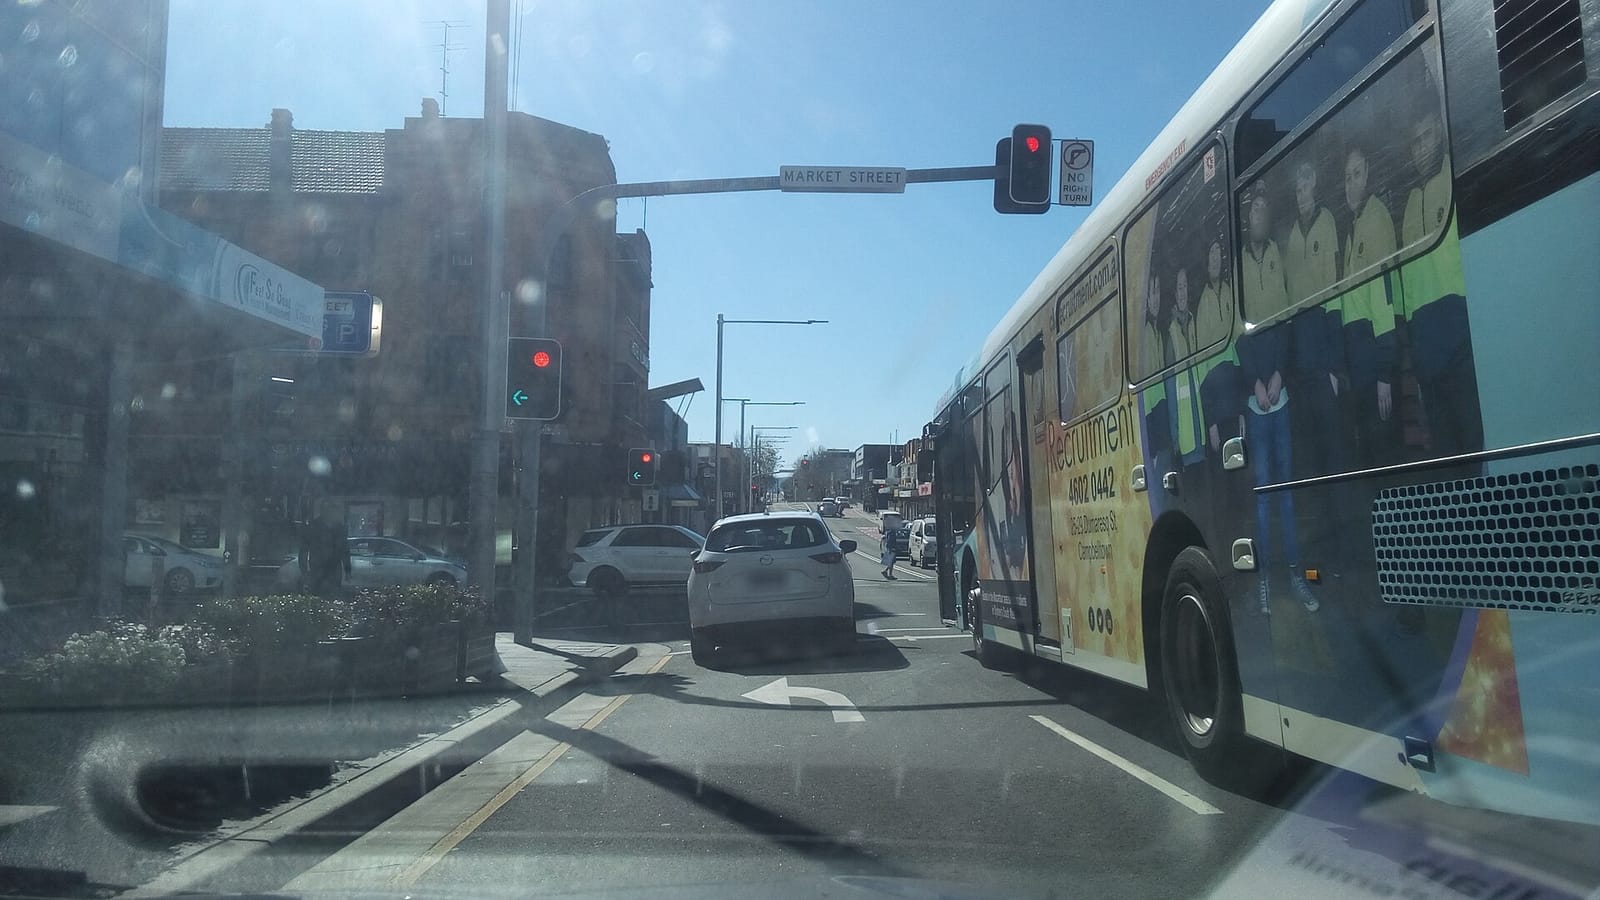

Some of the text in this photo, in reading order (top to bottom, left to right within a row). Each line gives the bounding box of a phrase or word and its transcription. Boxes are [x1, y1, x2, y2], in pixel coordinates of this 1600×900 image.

[1145, 139, 1186, 191] EMERGENCY EXIT
[784, 170, 902, 183] MARKET STREET
[1068, 172, 1085, 183] NO
[1064, 185, 1088, 193] RIGHT
[1064, 194, 1088, 202] TURN
[325, 301, 351, 312] EET
[339, 324, 355, 344] P
[1047, 391, 1135, 473] Recruitment
[1069, 466, 1115, 506] 4602 0442
[1110, 510, 1118, 531] St
